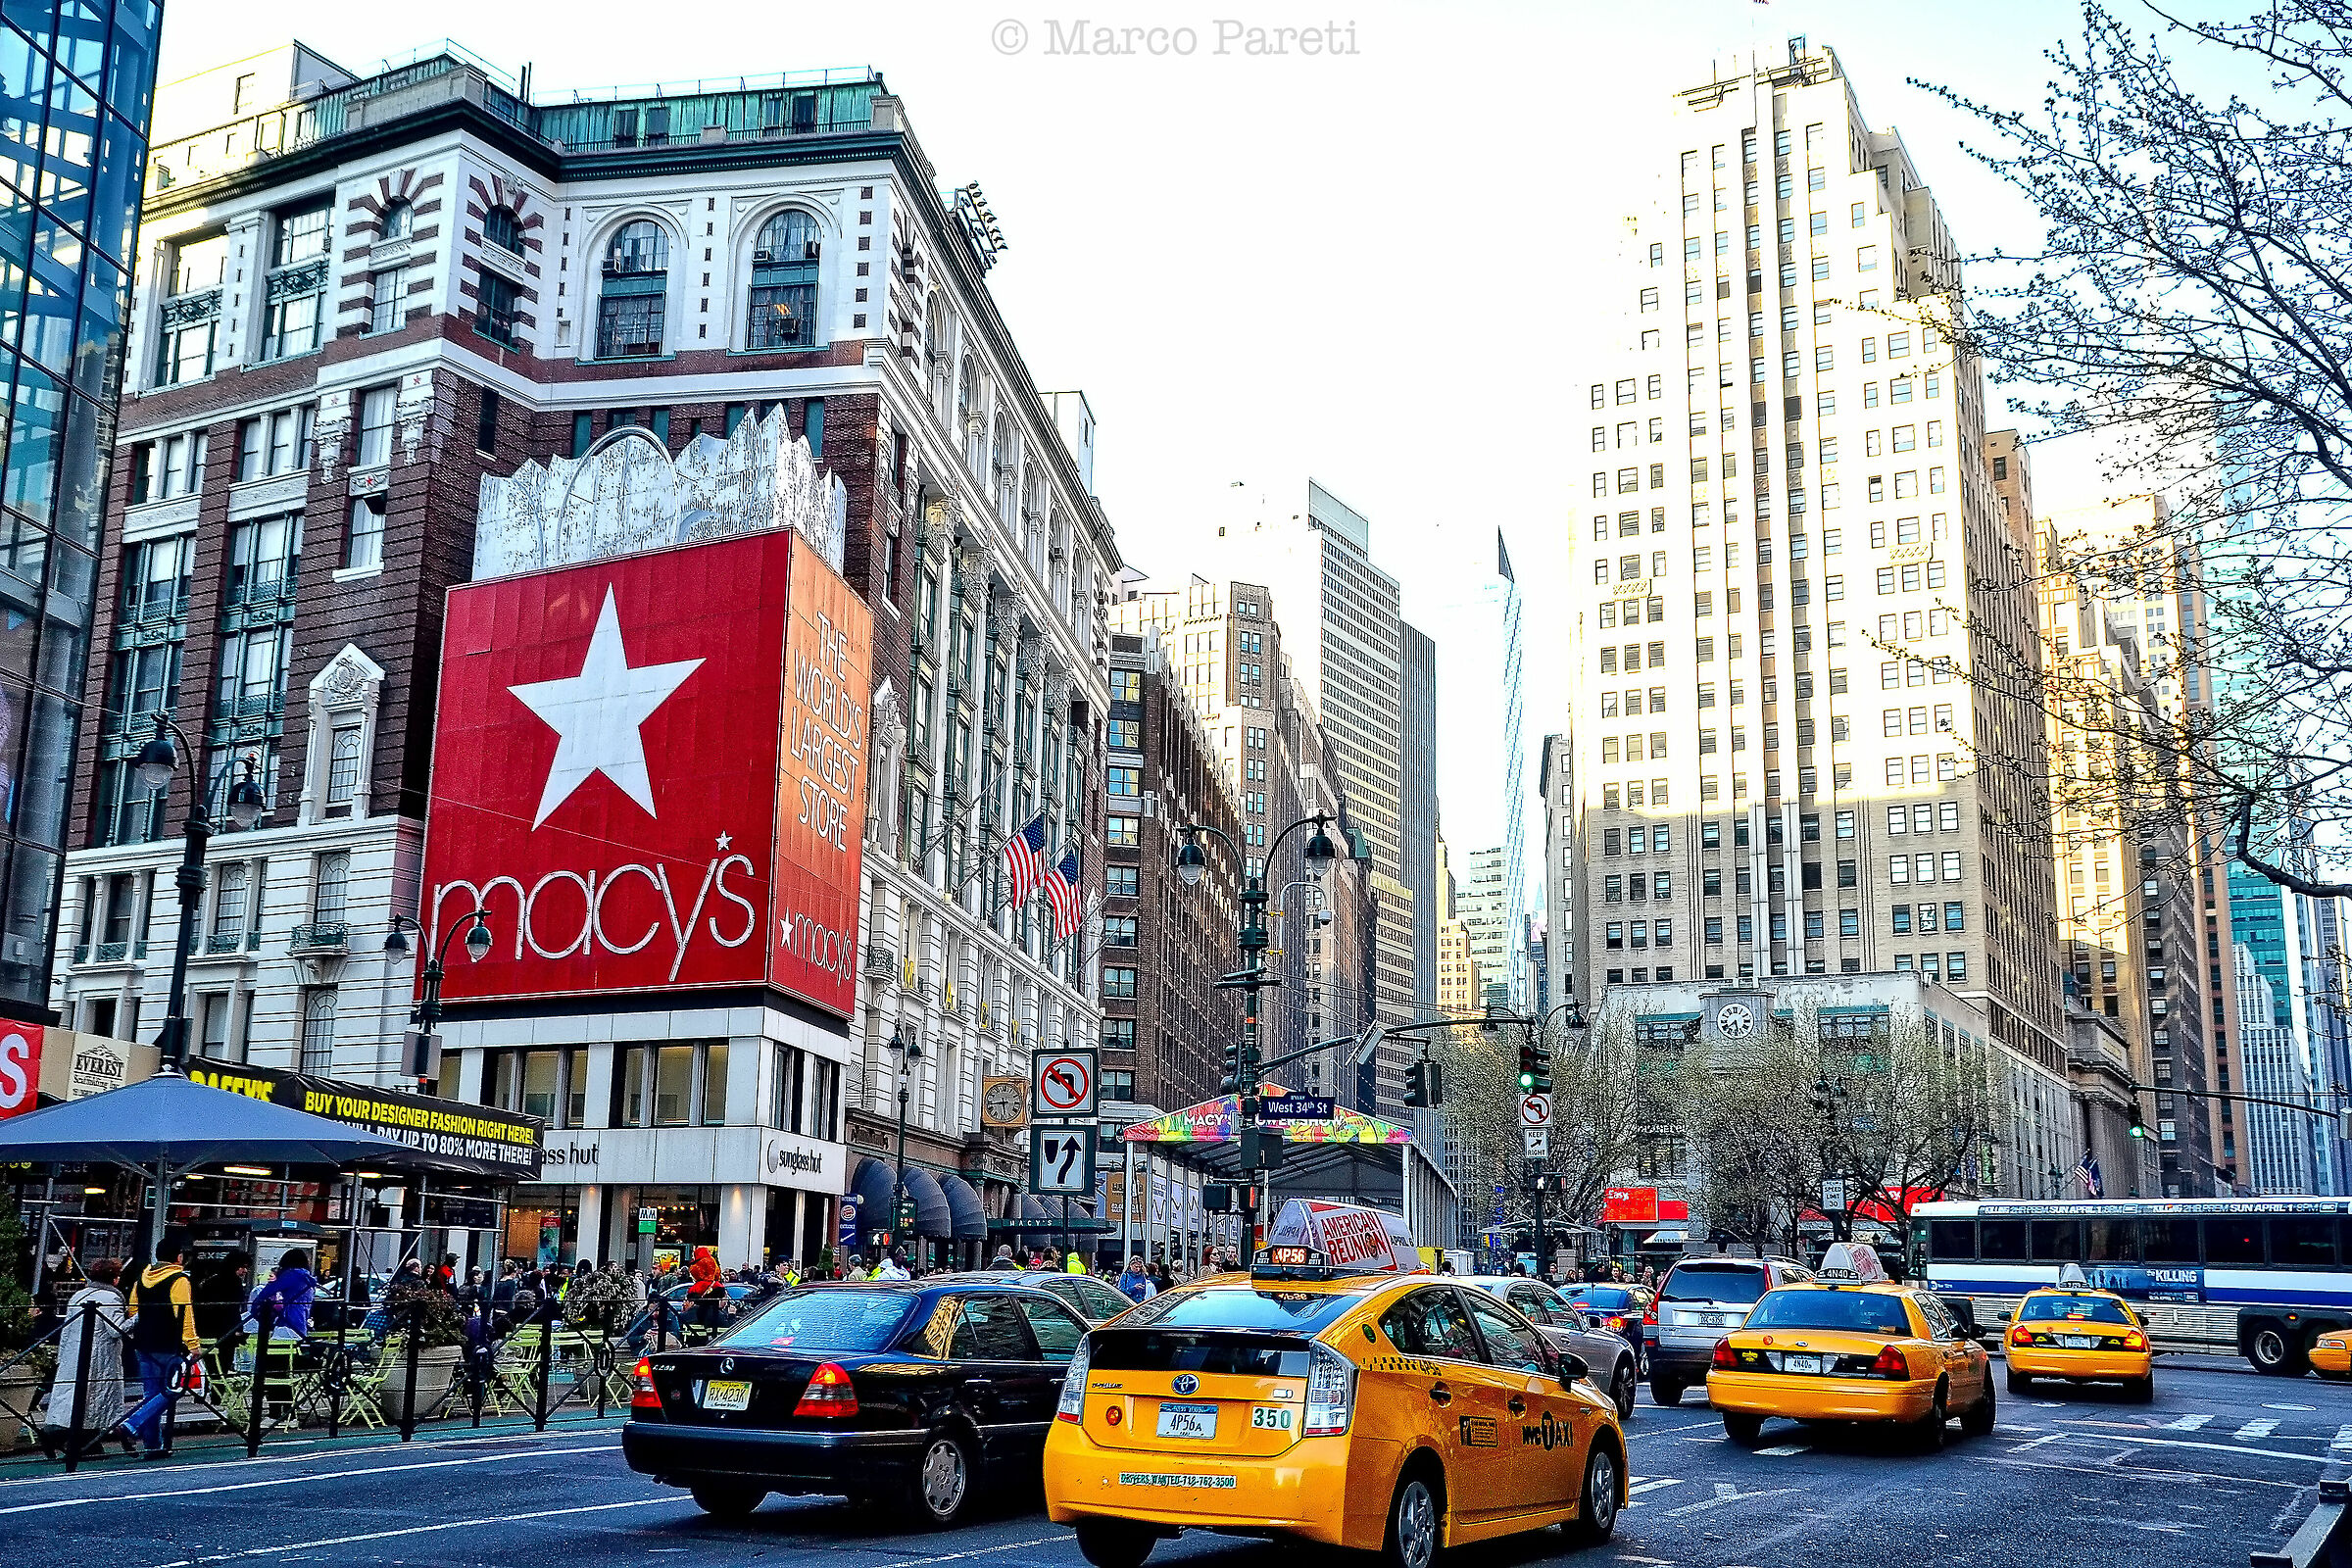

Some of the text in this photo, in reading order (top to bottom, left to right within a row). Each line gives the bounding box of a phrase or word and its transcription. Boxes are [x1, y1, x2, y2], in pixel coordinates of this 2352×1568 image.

[815, 611, 848, 681] THE
[794, 648, 862, 752] WORLD'S
[789, 713, 859, 803] LARGEST
[799, 781, 849, 854] STORE
[429, 830, 756, 982] macy's
[794, 911, 853, 986] macy's
[74, 1054, 124, 1078] EVEREST
[305, 1091, 334, 1114] BUY
[335, 1096, 369, 1120] YOUR
[371, 1102, 428, 1130] DESIGNER
[429, 1112, 476, 1136] FASHION
[477, 1120, 508, 1141] RIGHT
[508, 1124, 534, 1146] HERE!
[1267, 1101, 1328, 1114] West 34th St
[403, 1130, 419, 1147] UP
[421, 1133, 438, 1152] TO
[440, 1136, 464, 1157] 80%
[466, 1139, 497, 1161] MORE
[498, 1144, 533, 1166] THERE!
[569, 1141, 599, 1165] hut
[778, 1146, 822, 1176] sunglass hut
[2296, 1203, 2319, 1212] 8PM
[1320, 1210, 1380, 1241] AMERICAN
[1274, 1248, 1305, 1263] 4P56
[1327, 1230, 1389, 1266] REUNION
[1389, 1235, 1414, 1248] APRIL 6
[1827, 1269, 1848, 1279] 4N40
[2155, 1269, 2197, 1283] KILLING
[1170, 1413, 1202, 1432] 4P56A
[1253, 1407, 1292, 1429] 350
[1522, 1425, 1542, 1446] NYC
[1542, 1412, 1574, 1449] TAXI
